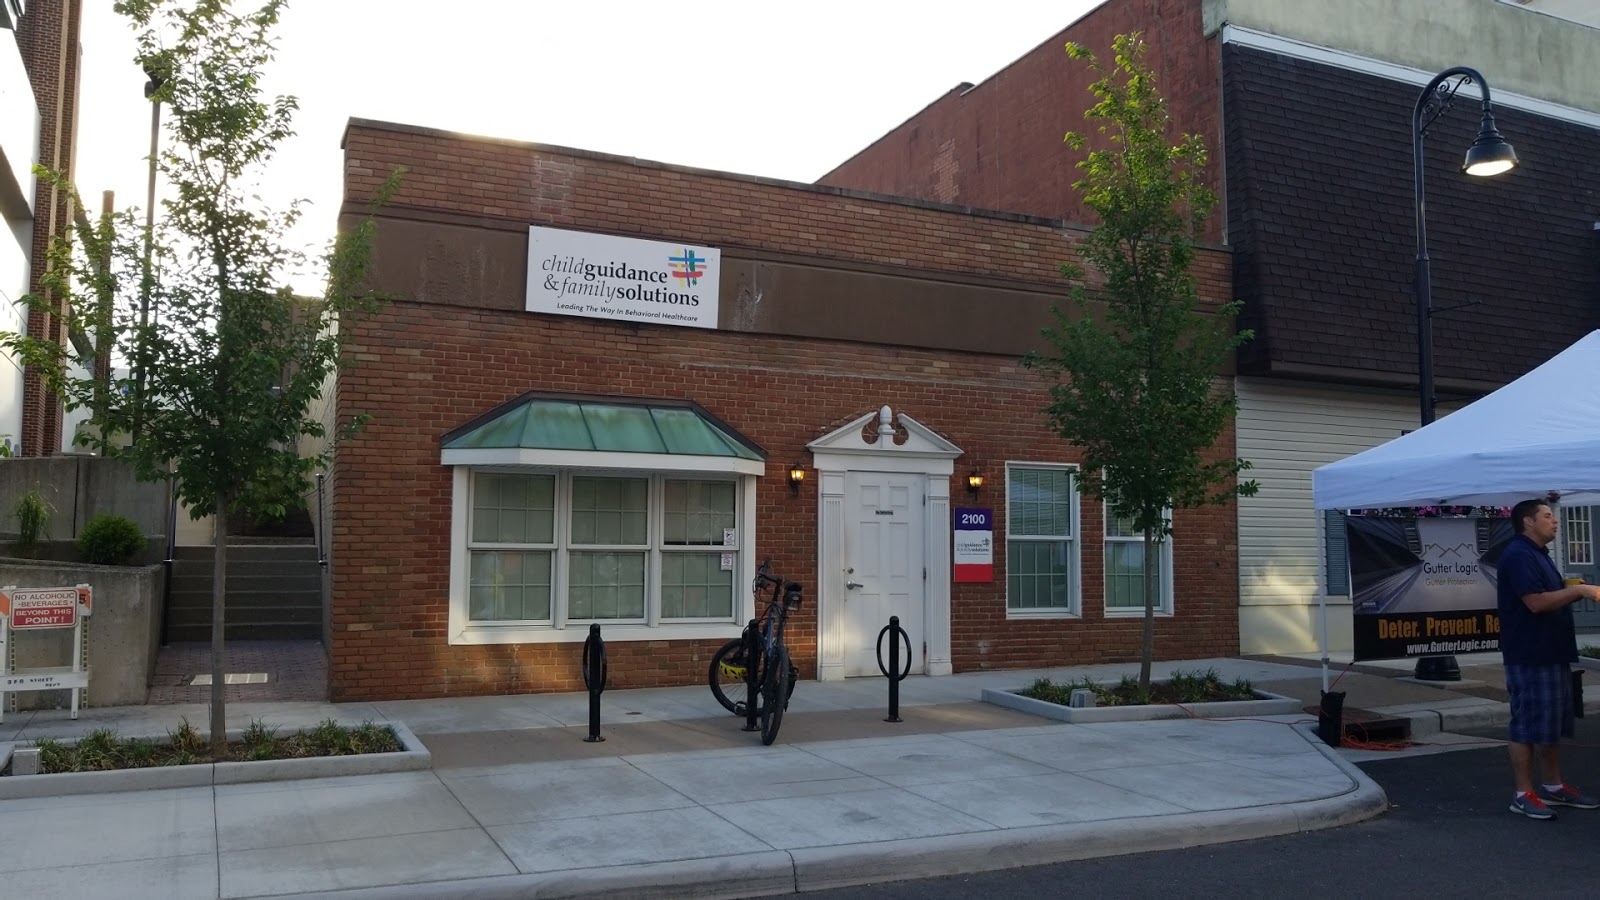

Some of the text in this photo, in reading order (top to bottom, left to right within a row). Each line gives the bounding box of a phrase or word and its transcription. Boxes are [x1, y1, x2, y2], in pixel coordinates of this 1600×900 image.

[557, 302, 584, 312] Leading
[600, 306, 615, 315] Way
[625, 309, 661, 319] Behavioral
[661, 312, 698, 322] Healthcare
[962, 514, 984, 524] 2100
[1423, 561, 1478, 576] Gutter Logic
[1425, 577, 1478, 586] Gutter Protection
[29, 592, 74, 600] ALCOHOLIC
[79, 593, 86, 604] 5
[1379, 613, 1500, 639] Deter. Prevent. Re
[1406, 638, 1499, 655] www.GutterLogic.com
